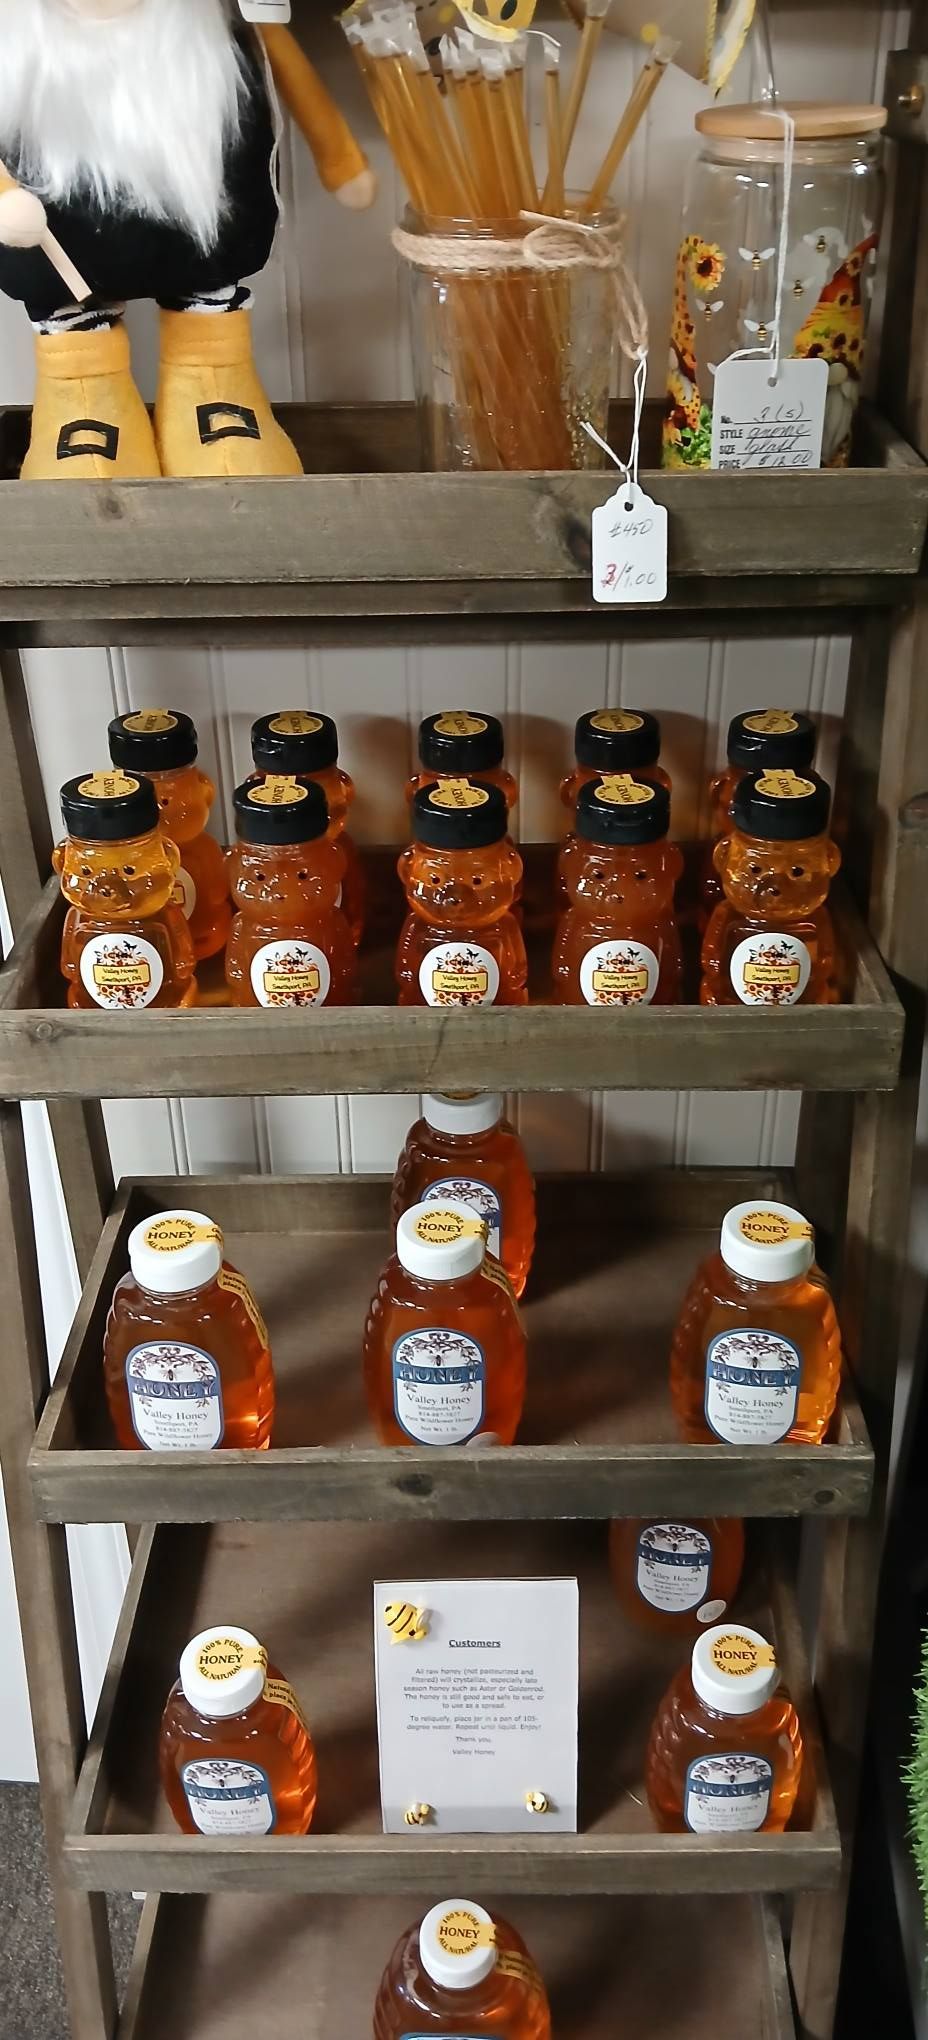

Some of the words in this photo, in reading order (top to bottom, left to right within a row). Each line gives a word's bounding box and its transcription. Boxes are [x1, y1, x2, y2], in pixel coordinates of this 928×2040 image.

[720, 430, 743, 438] STYLE
[720, 445, 736, 454] SIZE
[719, 460, 741, 468] PRICE
[421, 1211, 441, 1222] 100%
[444, 1211, 464, 1224] PURE
[744, 1212, 764, 1221] 100%
[767, 1213, 789, 1225] PURE
[152, 1220, 172, 1230] 100%
[176, 1219, 196, 1230] PURE
[417, 1222, 464, 1232] HONEY
[742, 1222, 790, 1233] HONEY
[148, 1230, 196, 1239] HONEY
[416, 1230, 427, 1242] ALL
[427, 1232, 462, 1244] NATURAL
[741, 1230, 753, 1240] ALL
[753, 1234, 789, 1244] NATURAL
[147, 1240, 158, 1250] ALL
[159, 1240, 194, 1251] NATURAL
[400, 1369, 478, 1383] HONEY
[713, 1365, 794, 1385] HONEY
[134, 1382, 216, 1397] HONEY
[407, 1394, 436, 1405] Valley
[719, 1393, 749, 1406] Valley
[753, 1400, 784, 1408] Honey
[143, 1408, 172, 1420] Valley
[202, 1640, 222, 1653] 100%
[224, 1639, 243, 1653] PURE
[449, 1640, 501, 1648] Customers
[714, 1636, 732, 1647] 100%
[736, 1635, 755, 1649] PURE
[199, 1654, 244, 1664] HONEY
[713, 1650, 757, 1660] HONEY
[199, 1665, 209, 1677] ALL
[209, 1665, 241, 1680] NATURAL
[715, 1661, 726, 1672] ALL
[728, 1661, 757, 1675] NATURAL
[442, 1912, 461, 1924] 100%
[463, 1912, 480, 1927] PURE
[439, 1926, 480, 1939] HONEY
[439, 1937, 448, 1950] ALL
[449, 1941, 478, 1954] NATURAL
